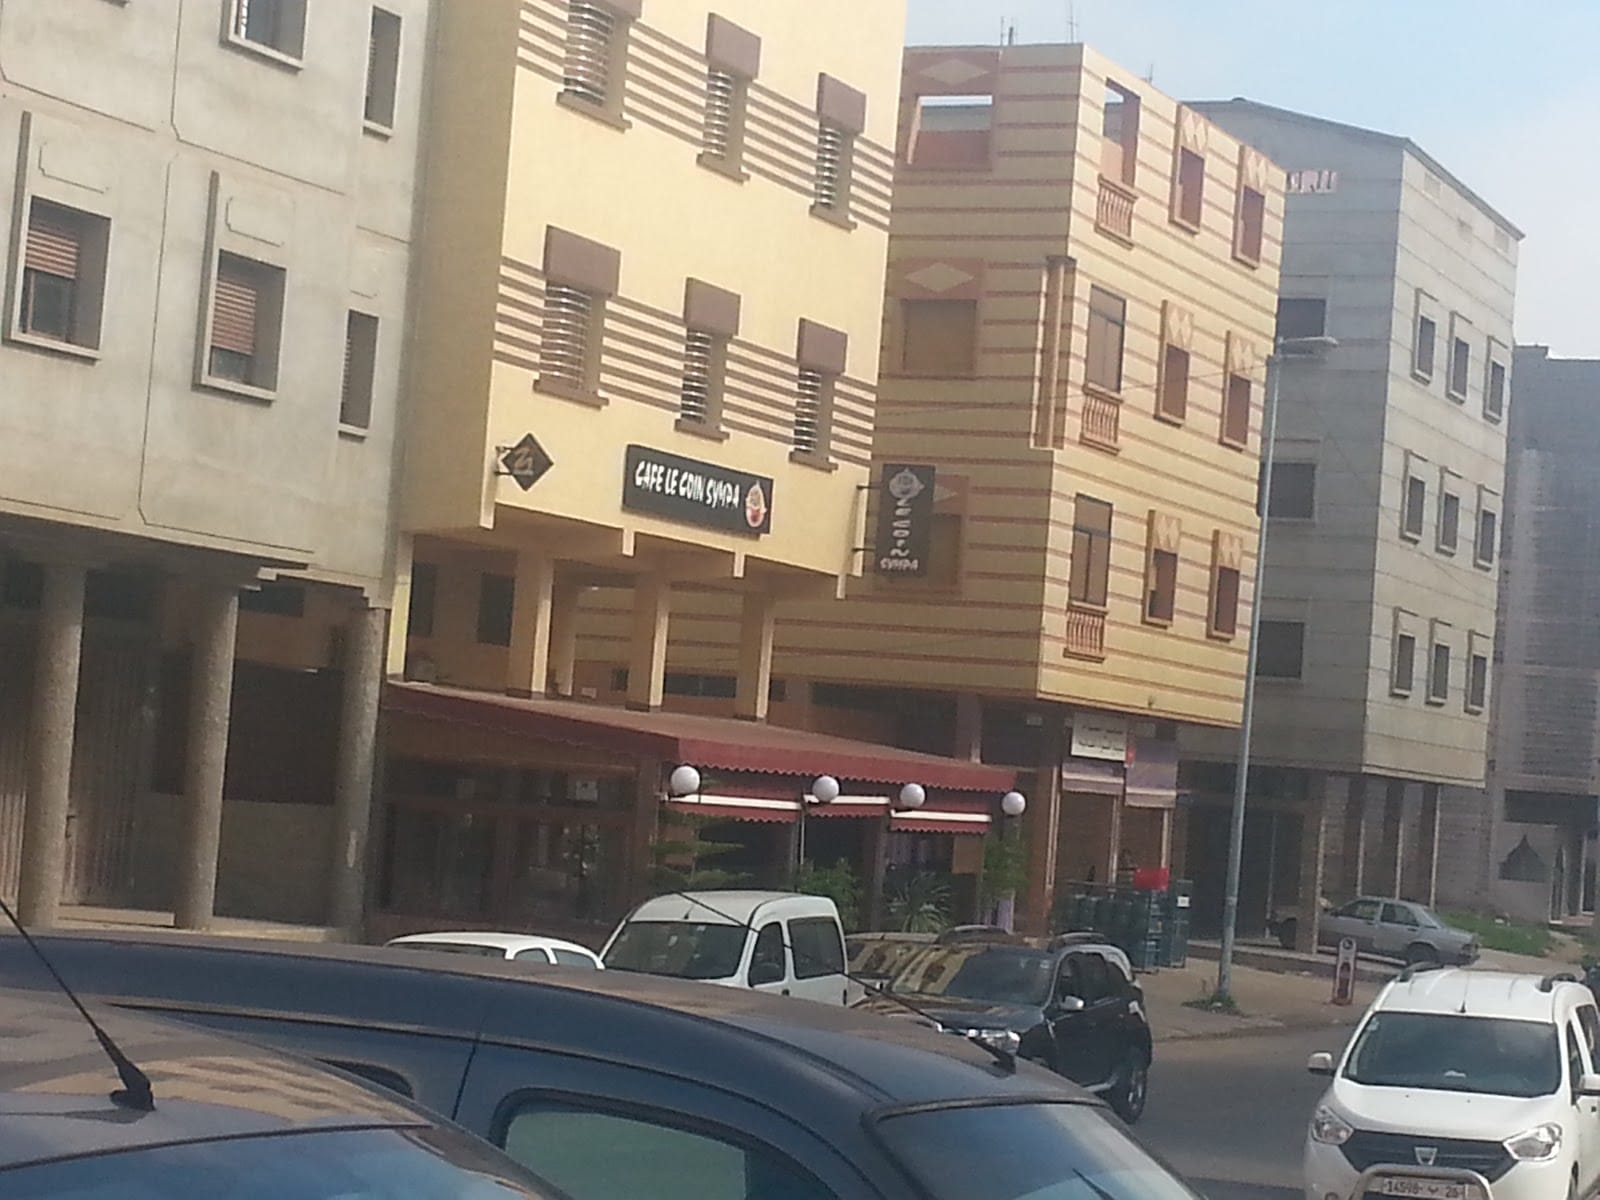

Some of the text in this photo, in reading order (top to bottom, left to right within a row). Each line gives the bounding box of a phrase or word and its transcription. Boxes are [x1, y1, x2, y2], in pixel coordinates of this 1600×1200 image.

[635, 460, 665, 493] CAFE
[665, 467, 679, 496] LE
[679, 471, 704, 503] COIN
